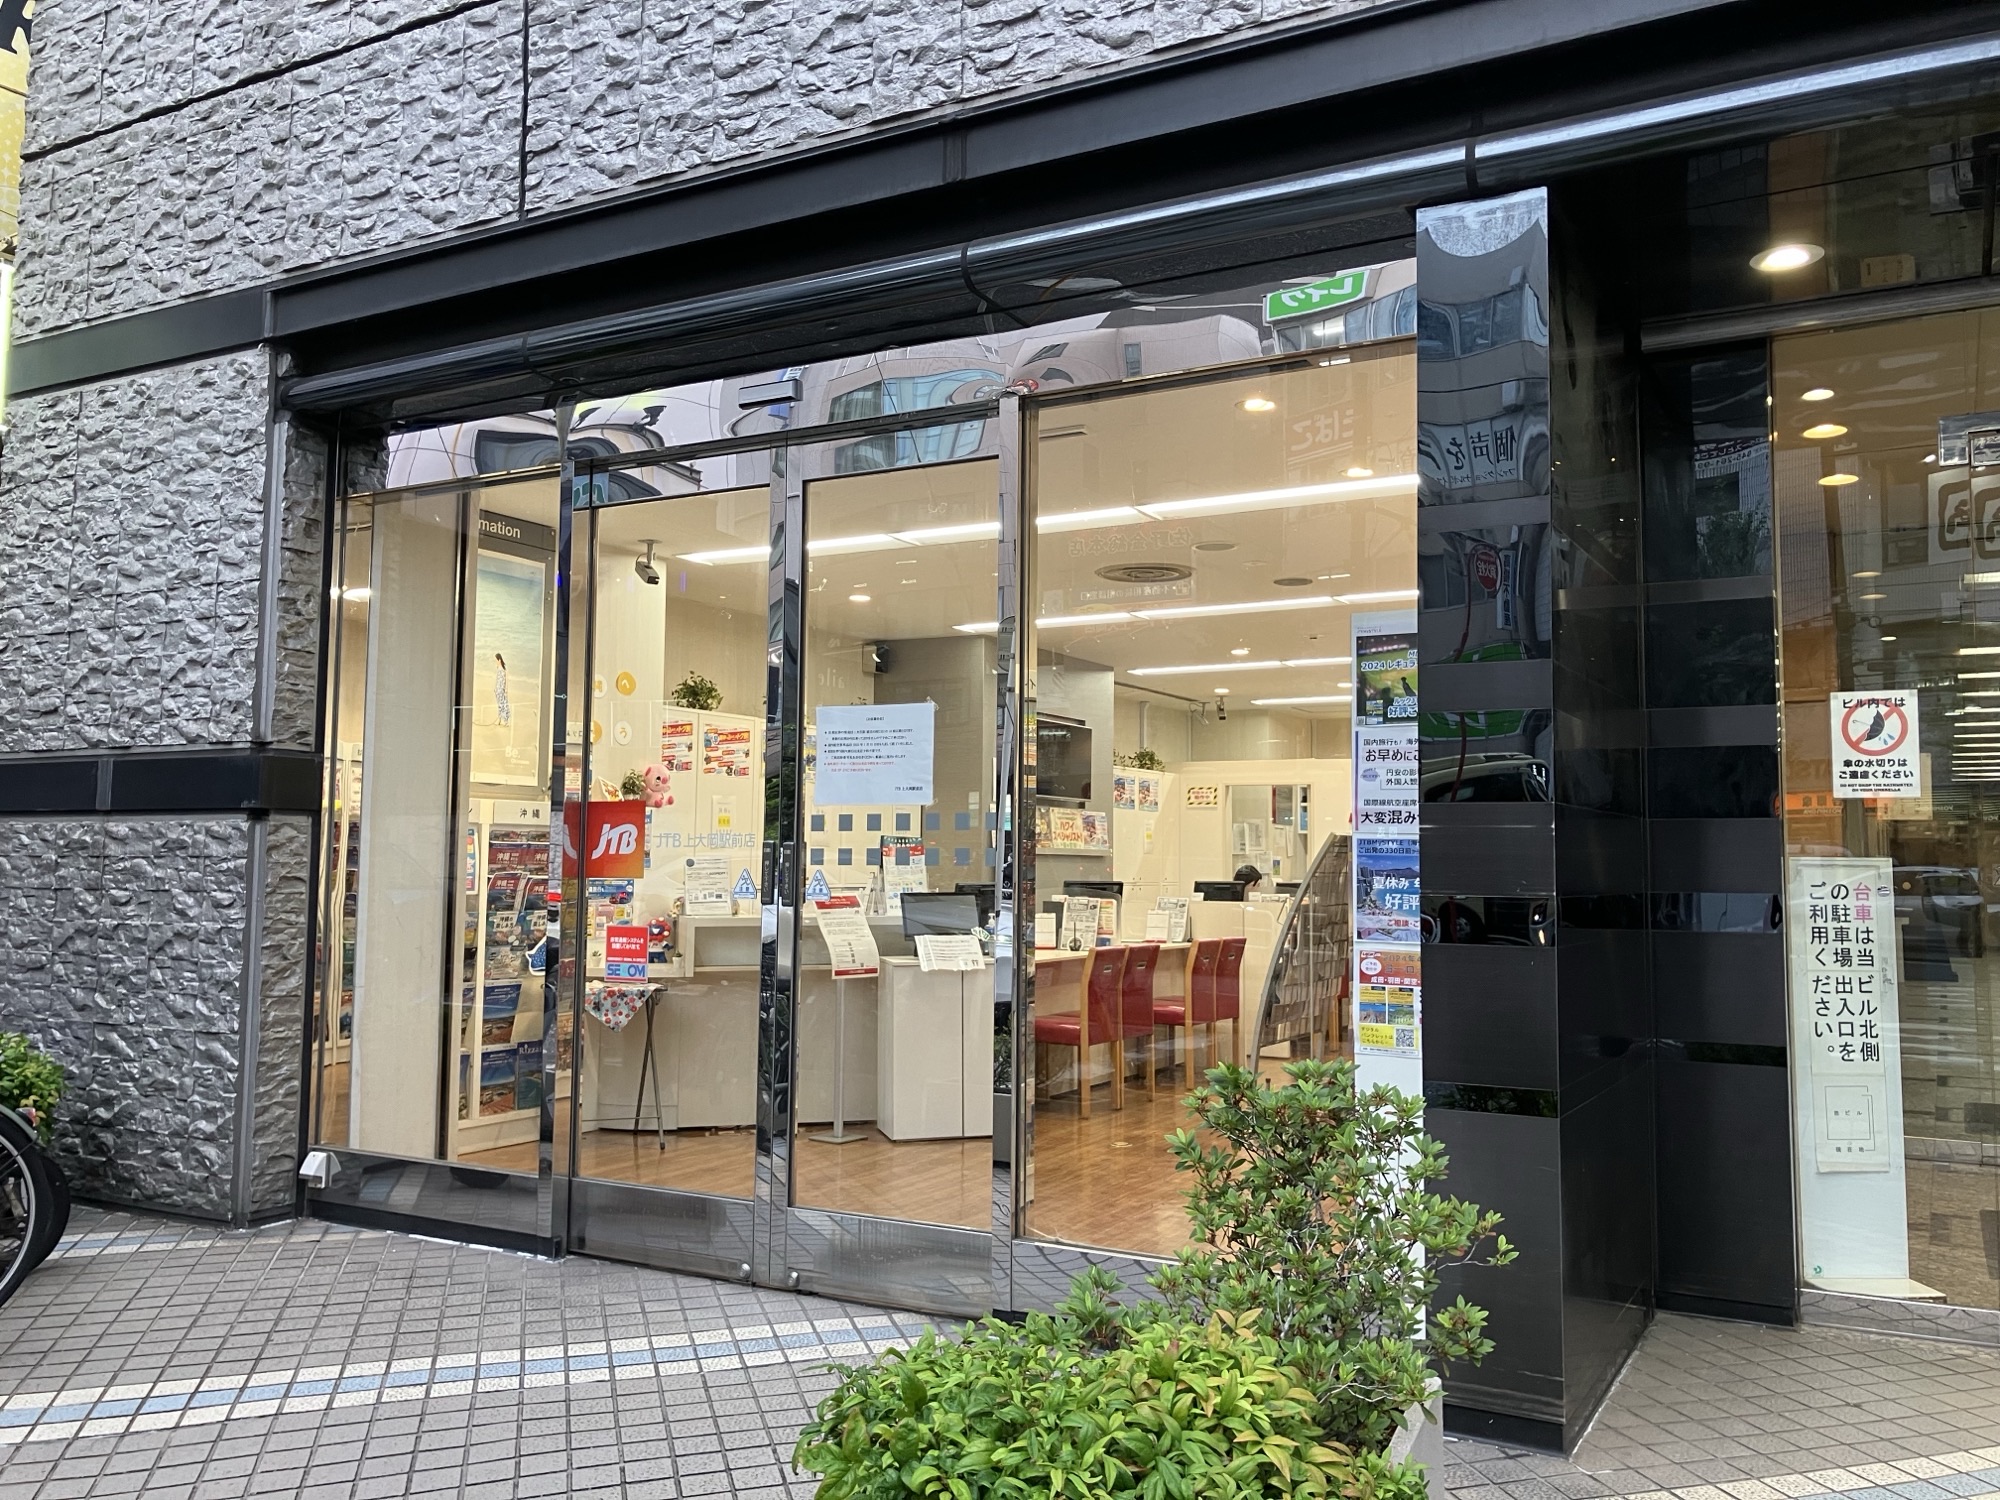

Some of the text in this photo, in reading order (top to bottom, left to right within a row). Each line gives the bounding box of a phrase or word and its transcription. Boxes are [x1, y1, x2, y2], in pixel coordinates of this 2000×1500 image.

[1361, 661, 1385, 671] 2024
[1842, 697, 1906, 708] ビル内では
[1843, 759, 1908, 768] 傘の水切りは
[1839, 770, 1914, 779] ご遠慮ください
[520, 808, 540, 819] 沖縄
[1360, 810, 1419, 824] 大変混み
[591, 823, 638, 860] JTB
[656, 833, 756, 848] JTB 上大岡駅前店
[1373, 876, 1409, 889] 夏休み
[607, 964, 645, 978] SEOM
[1809, 882, 1834, 1053] ご利用ください。
[1830, 884, 1855, 1061] の駐車場出入口を
[1853, 882, 1880, 1062] 台車は当ビル北側
